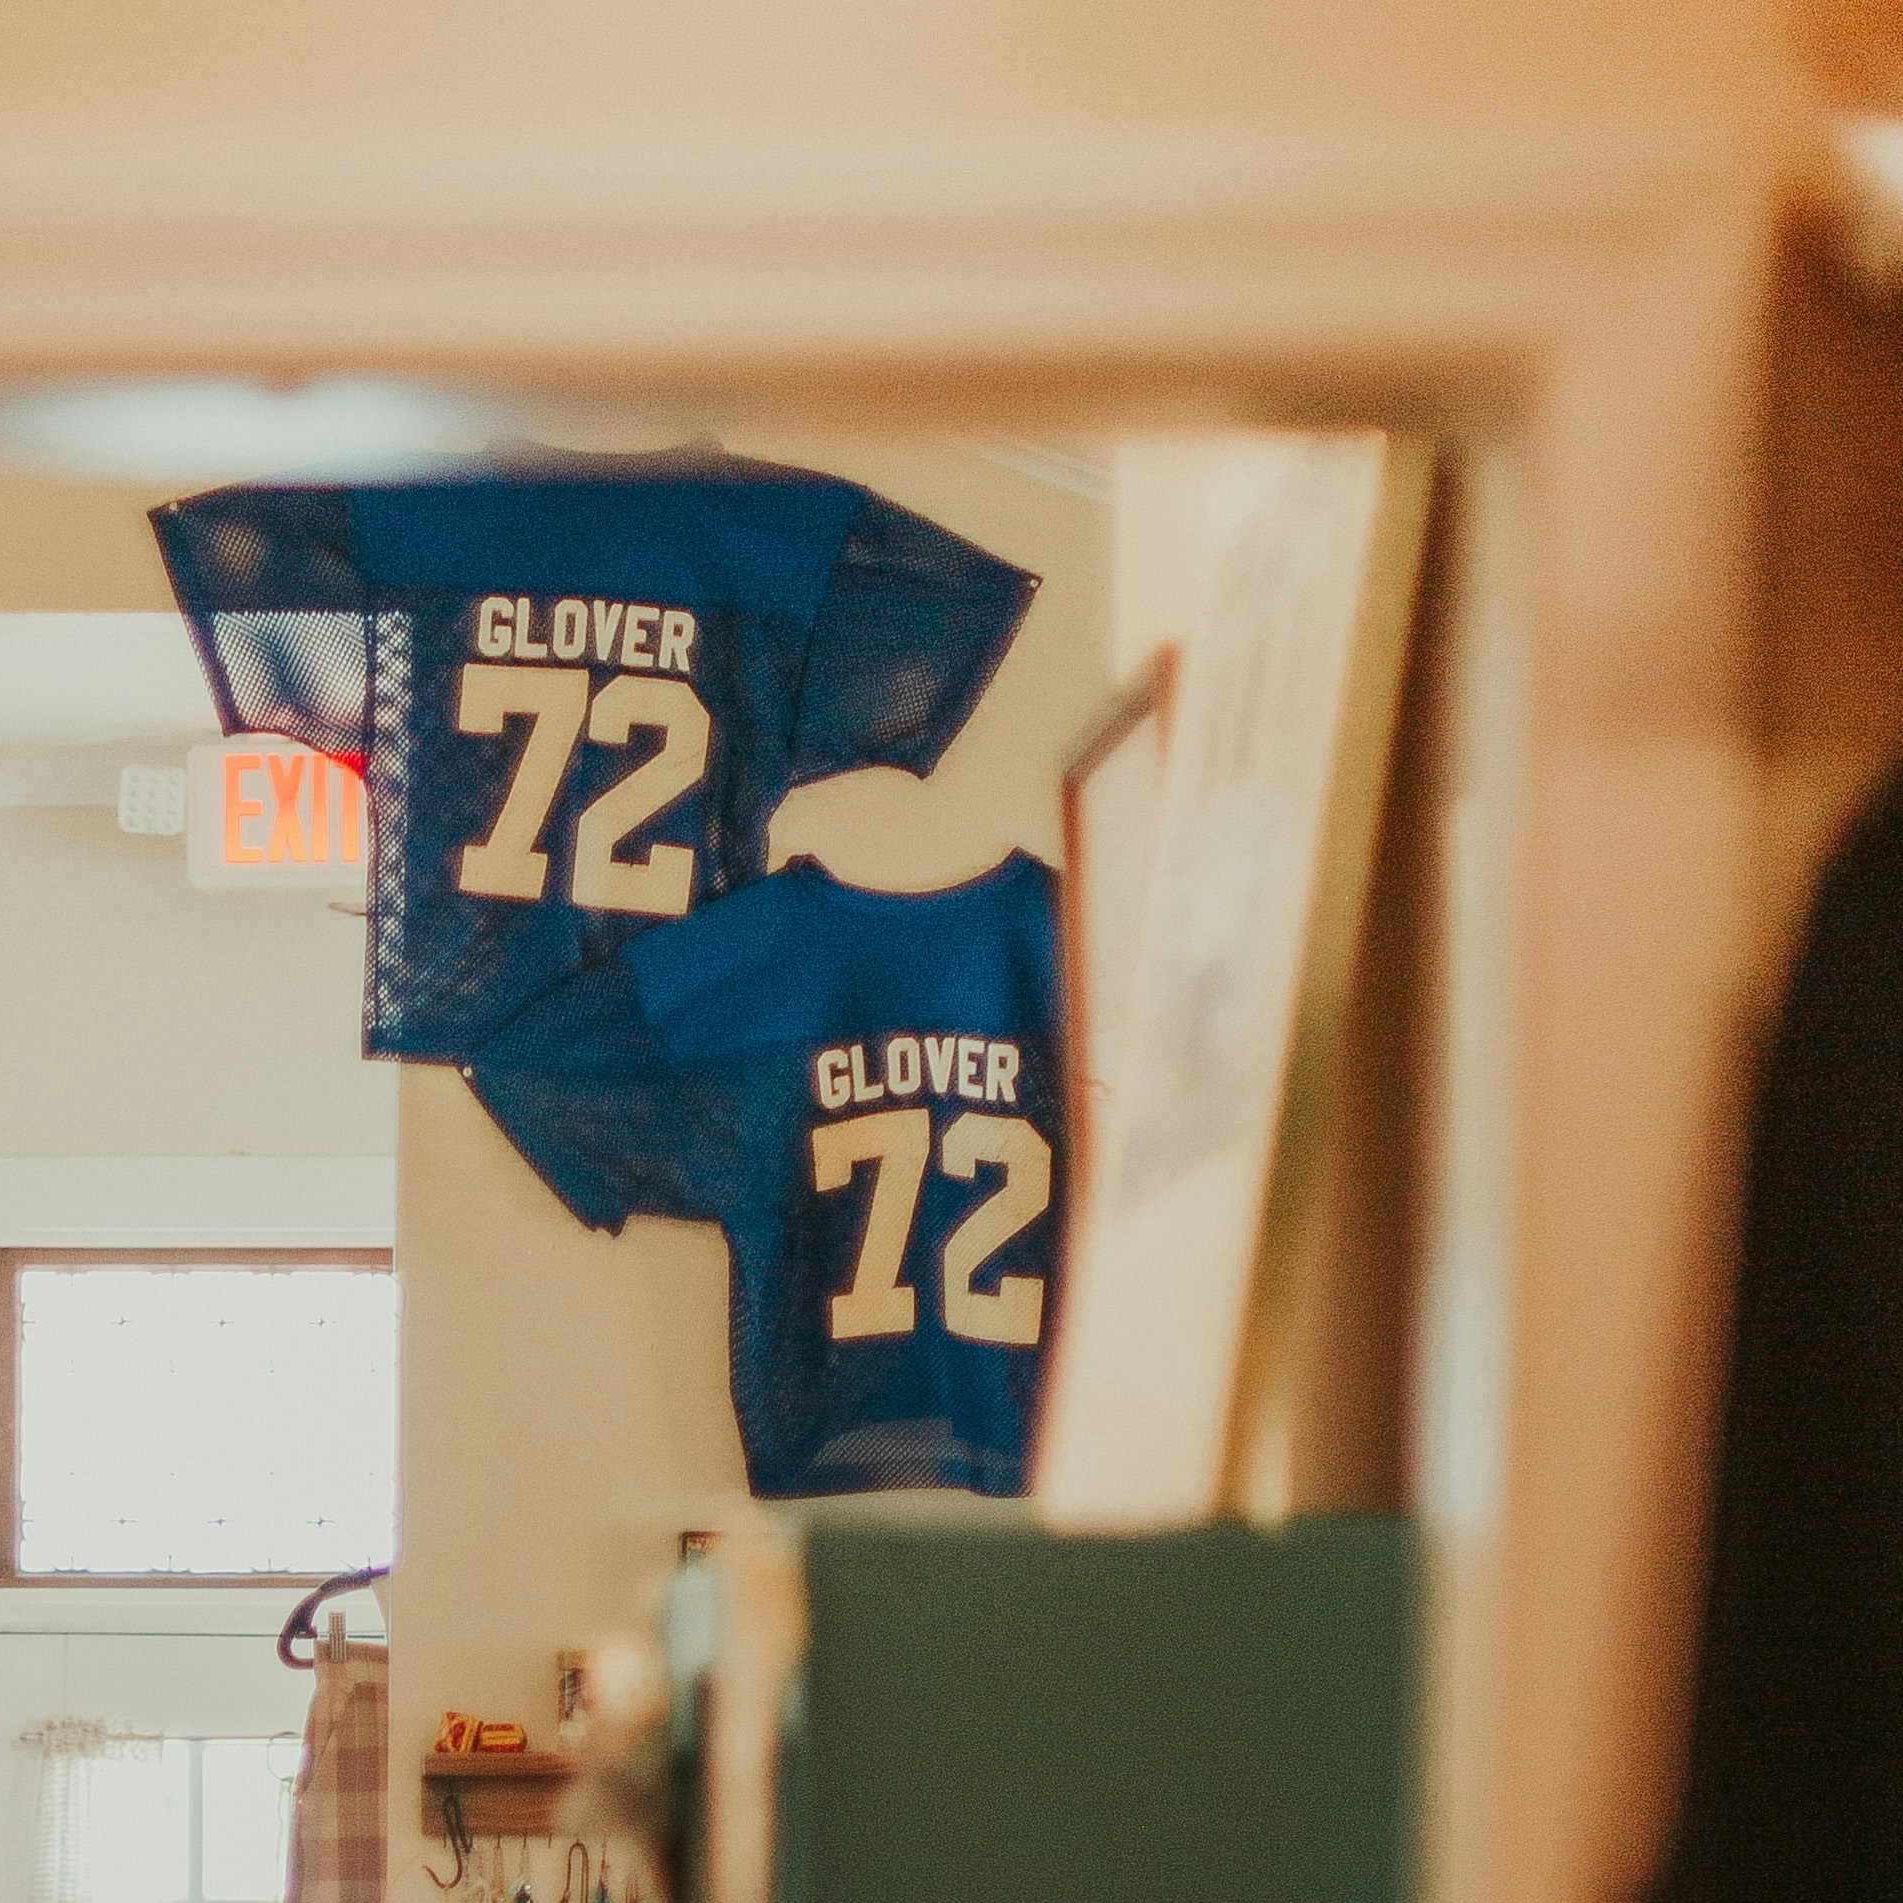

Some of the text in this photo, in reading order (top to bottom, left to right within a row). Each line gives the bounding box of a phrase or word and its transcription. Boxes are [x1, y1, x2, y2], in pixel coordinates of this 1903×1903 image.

[478, 596, 696, 672] GLOVER
[224, 754, 361, 864] EXIT
[458, 662, 711, 916] 72
[816, 1036, 1020, 1109] GLOVER
[812, 1107, 1053, 1345] 72
